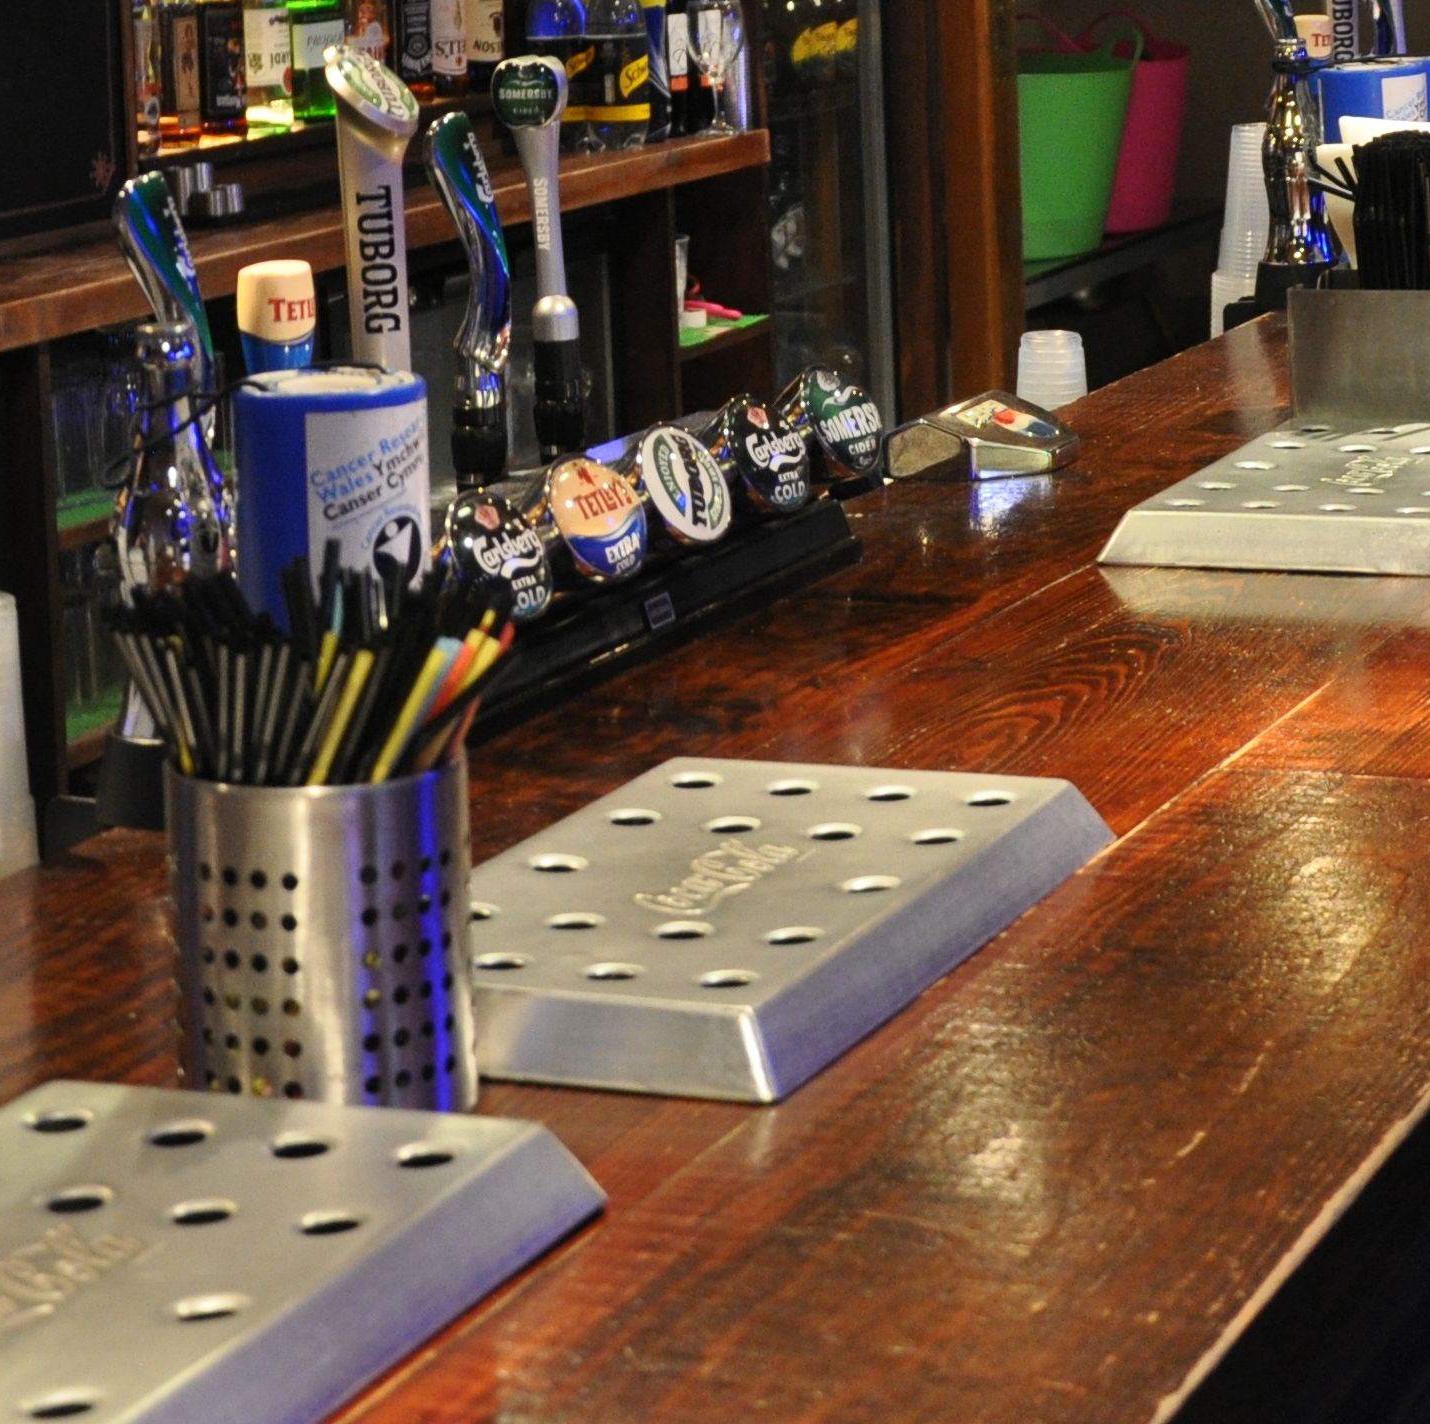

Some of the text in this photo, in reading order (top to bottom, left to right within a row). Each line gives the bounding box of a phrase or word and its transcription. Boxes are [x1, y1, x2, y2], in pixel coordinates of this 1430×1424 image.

[498, 87, 553, 100] SOMERSBY
[533, 177, 551, 251] SOMERSBY
[356, 184, 402, 335] TUBORG
[745, 430, 806, 468] Carlsberg
[848, 439, 878, 456] CIDER
[310, 450, 375, 487] Cancer
[777, 471, 800, 483] EXTRA
[318, 472, 375, 504] Wales
[323, 485, 382, 521] Canser
[774, 480, 807, 503] COLD
[473, 527, 545, 575] Carlsberg
[605, 530, 641, 564] EXTRA
[511, 574, 537, 591] EXTRA
[634, 838, 801, 917] Coca-Cola
